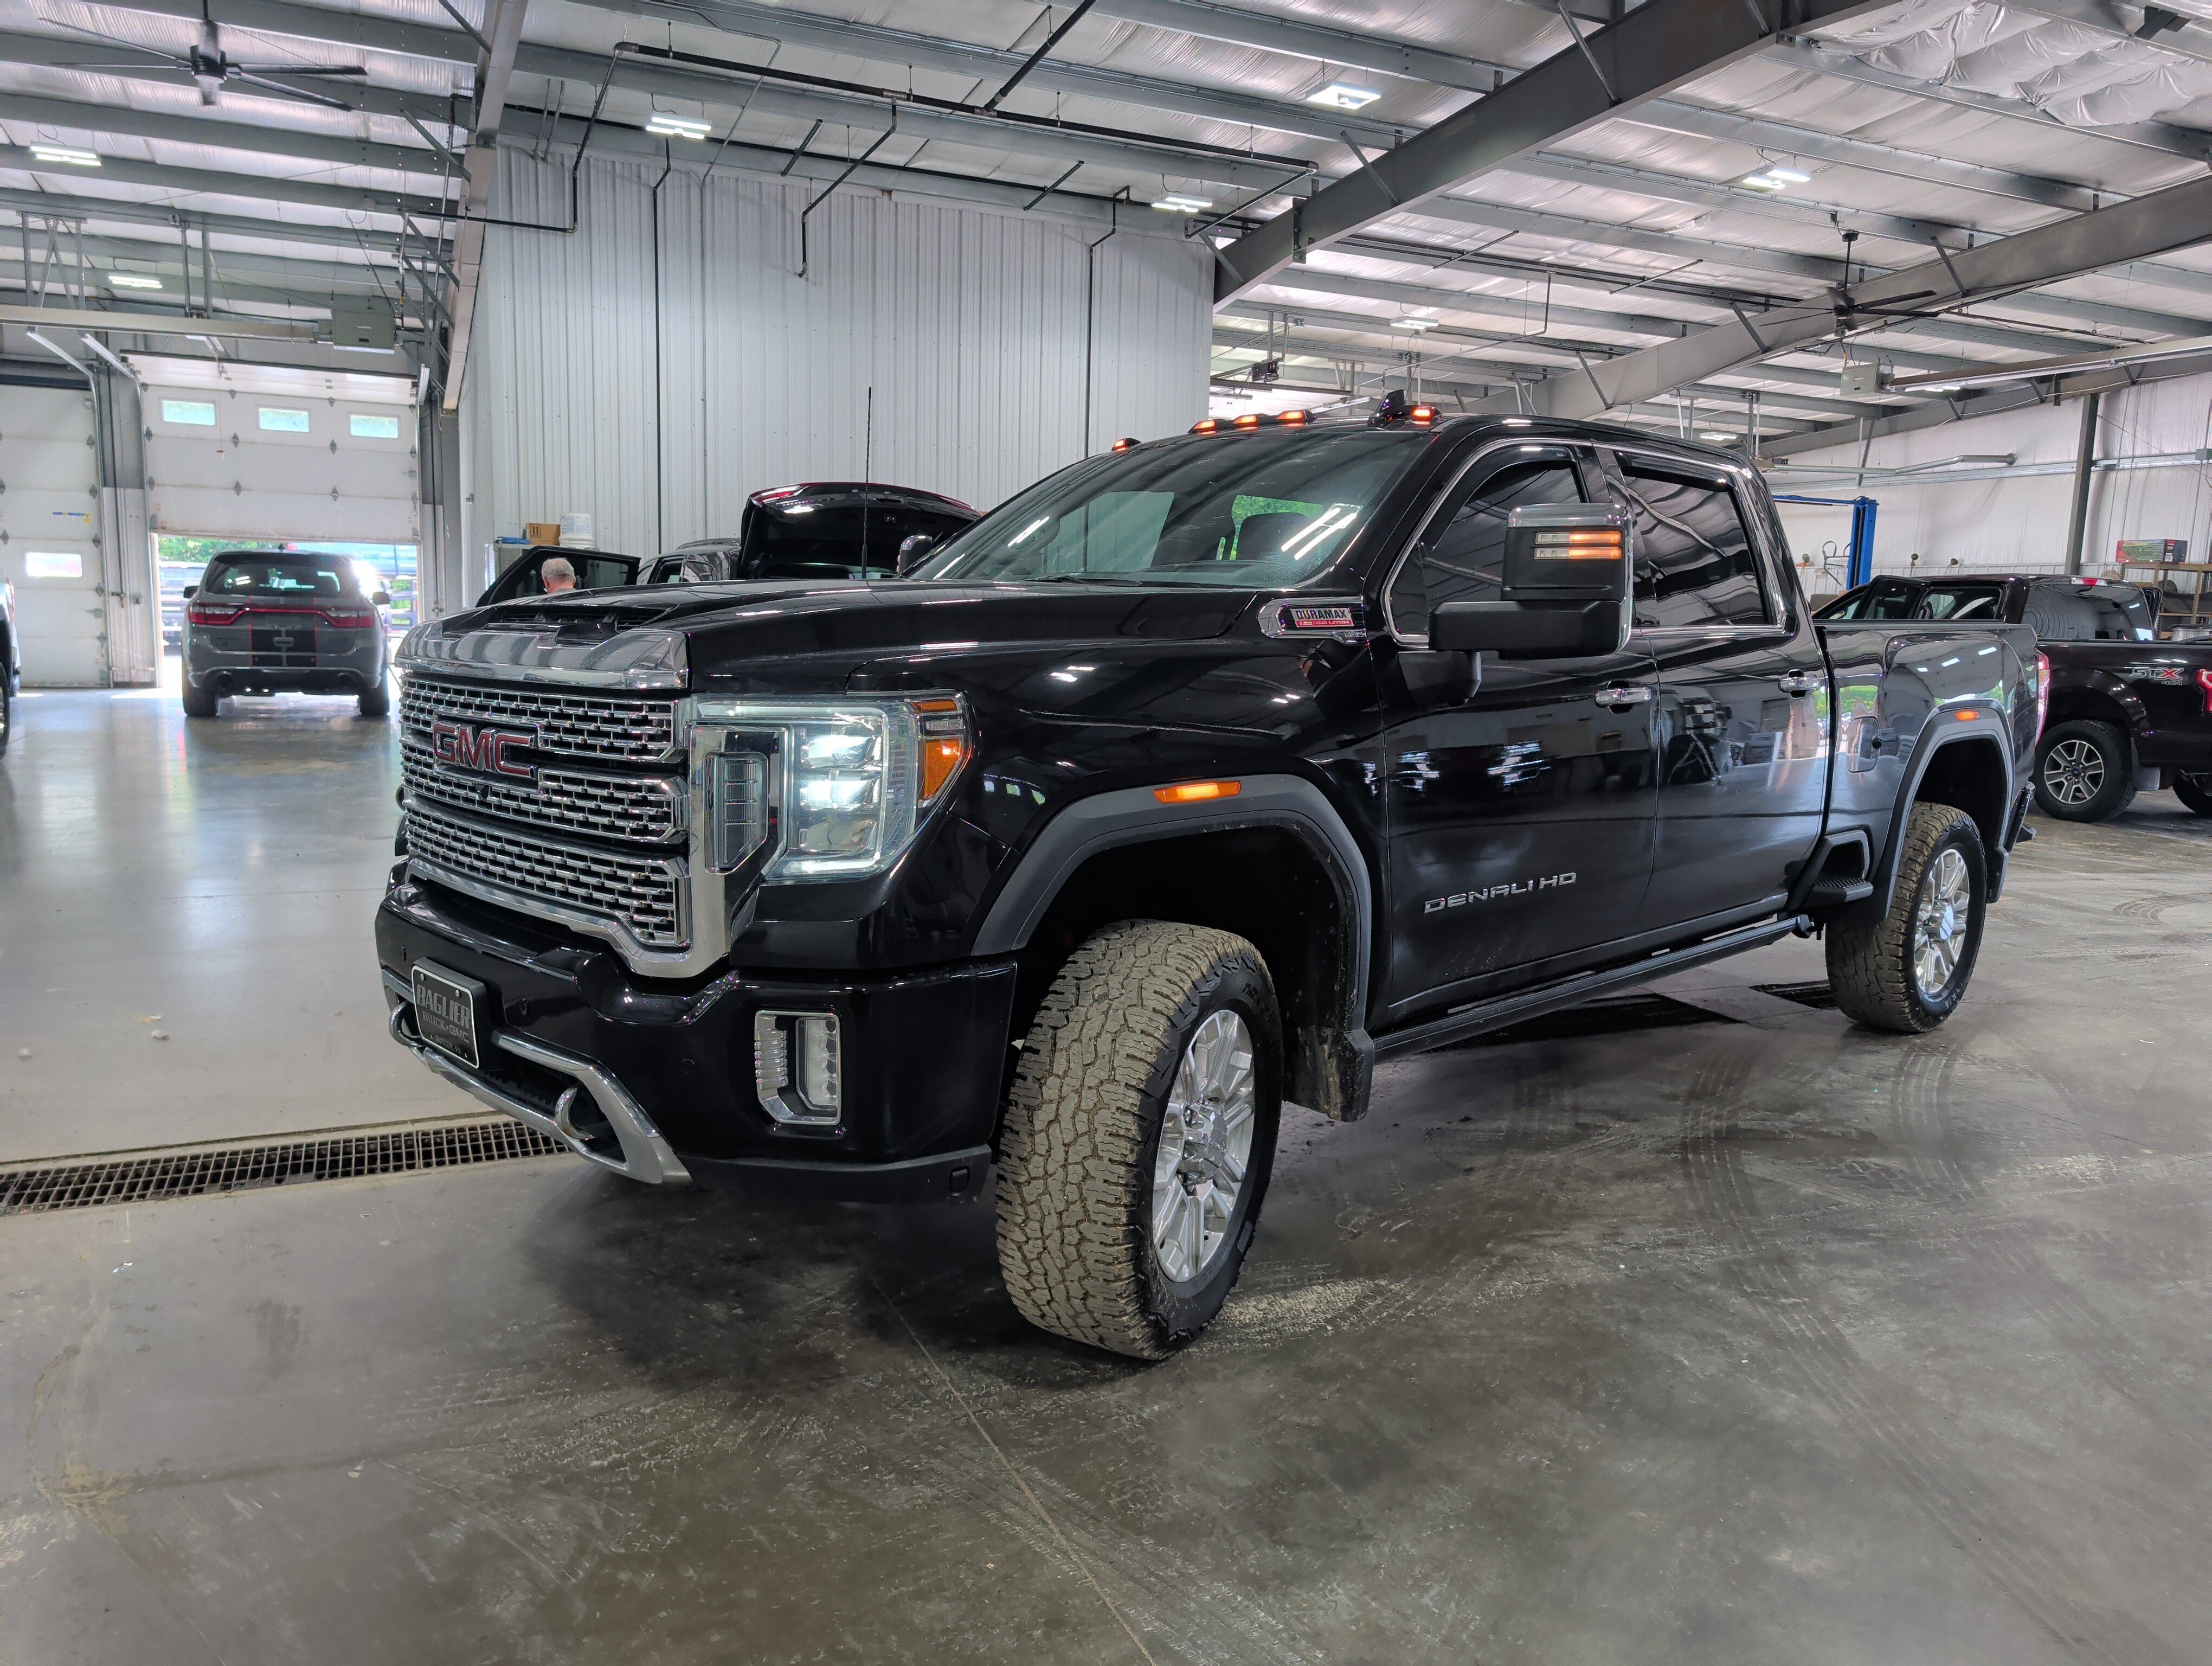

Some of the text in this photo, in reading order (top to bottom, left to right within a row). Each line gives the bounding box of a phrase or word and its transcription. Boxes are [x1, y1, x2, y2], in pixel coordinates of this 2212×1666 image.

[1295, 608, 1347, 619] DURAMAX
[2129, 667, 2184, 681] STX
[434, 722, 533, 778] GMC
[1424, 872, 1577, 914] DENALI HD
[416, 984, 471, 1029] BAGLIER
